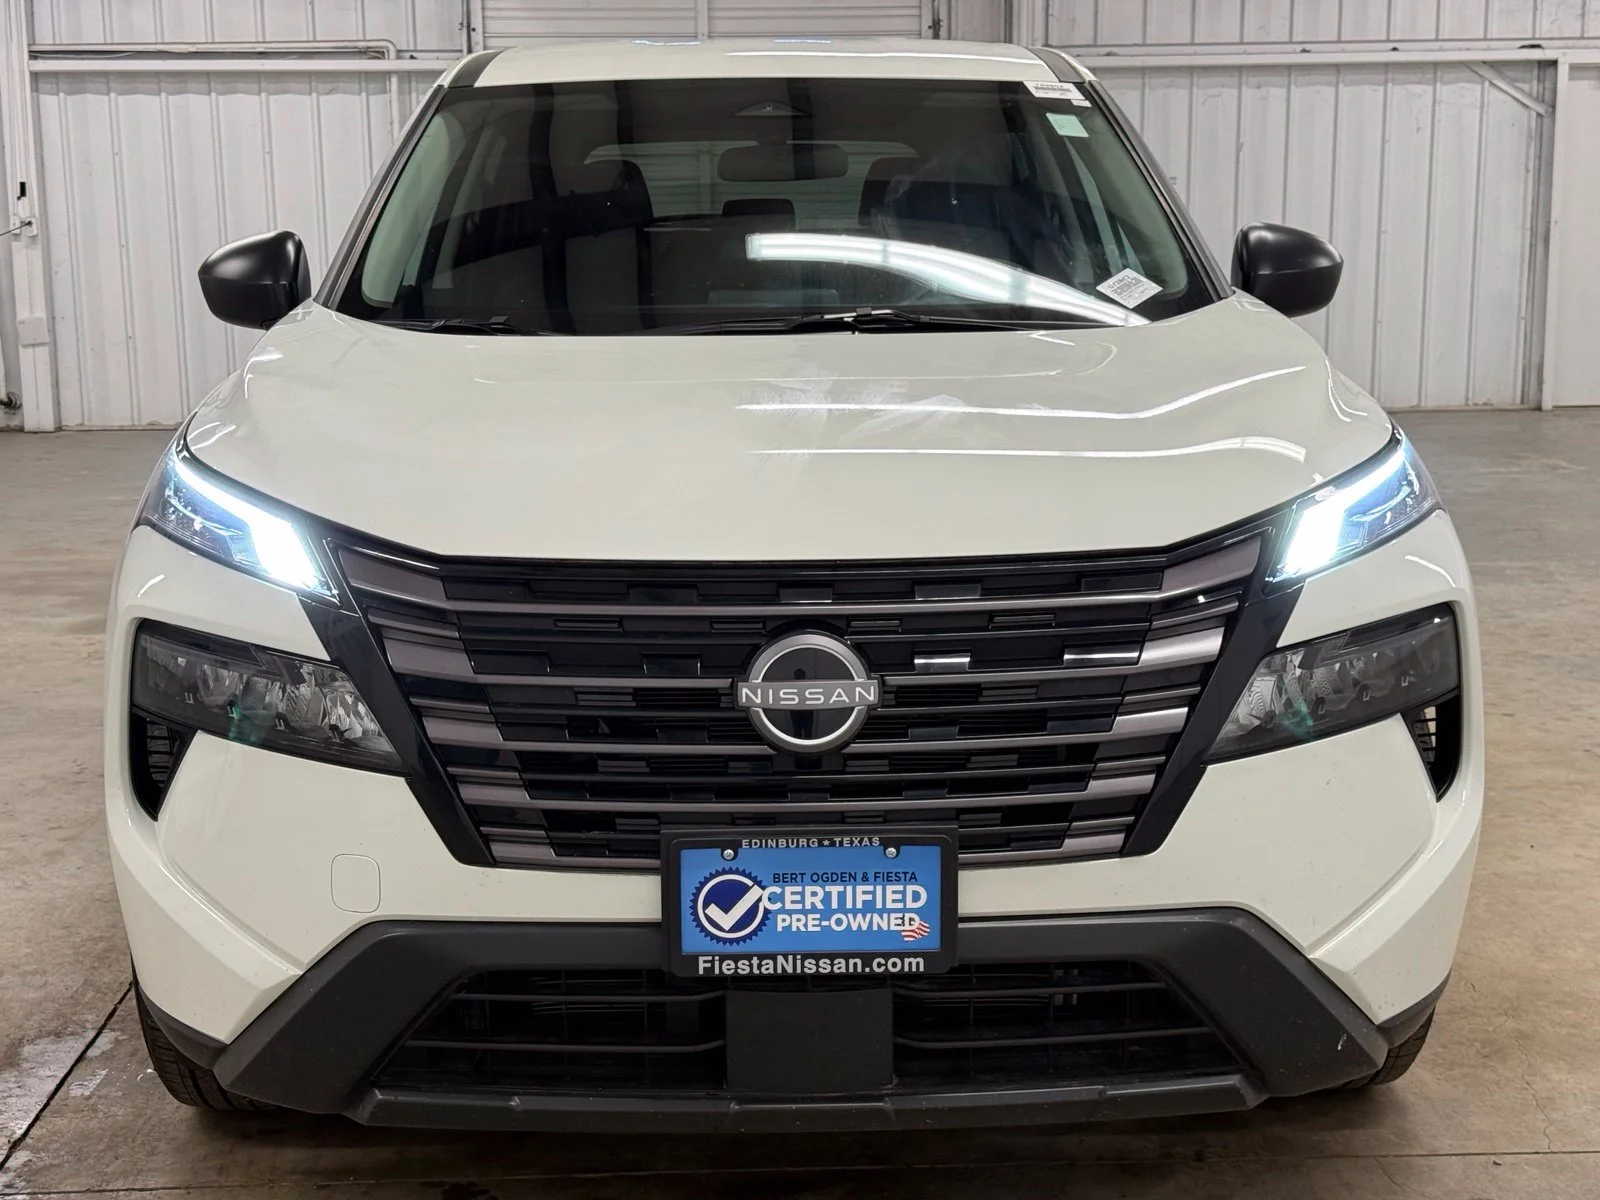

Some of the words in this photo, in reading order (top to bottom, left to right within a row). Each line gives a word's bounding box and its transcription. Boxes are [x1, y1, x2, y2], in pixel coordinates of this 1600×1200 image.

[742, 686, 874, 704] NISSAN
[742, 838, 819, 849] EDINBURG
[834, 837, 880, 847] TEXAS
[773, 872, 806, 884] BERT
[810, 872, 857, 883] OGDEN
[861, 872, 870, 882] &
[873, 871, 918, 882] FIESTA
[762, 884, 928, 910] CERTIFIED
[777, 912, 921, 932] PRE-OWNED
[698, 955, 925, 975] FiestaNissan.com
